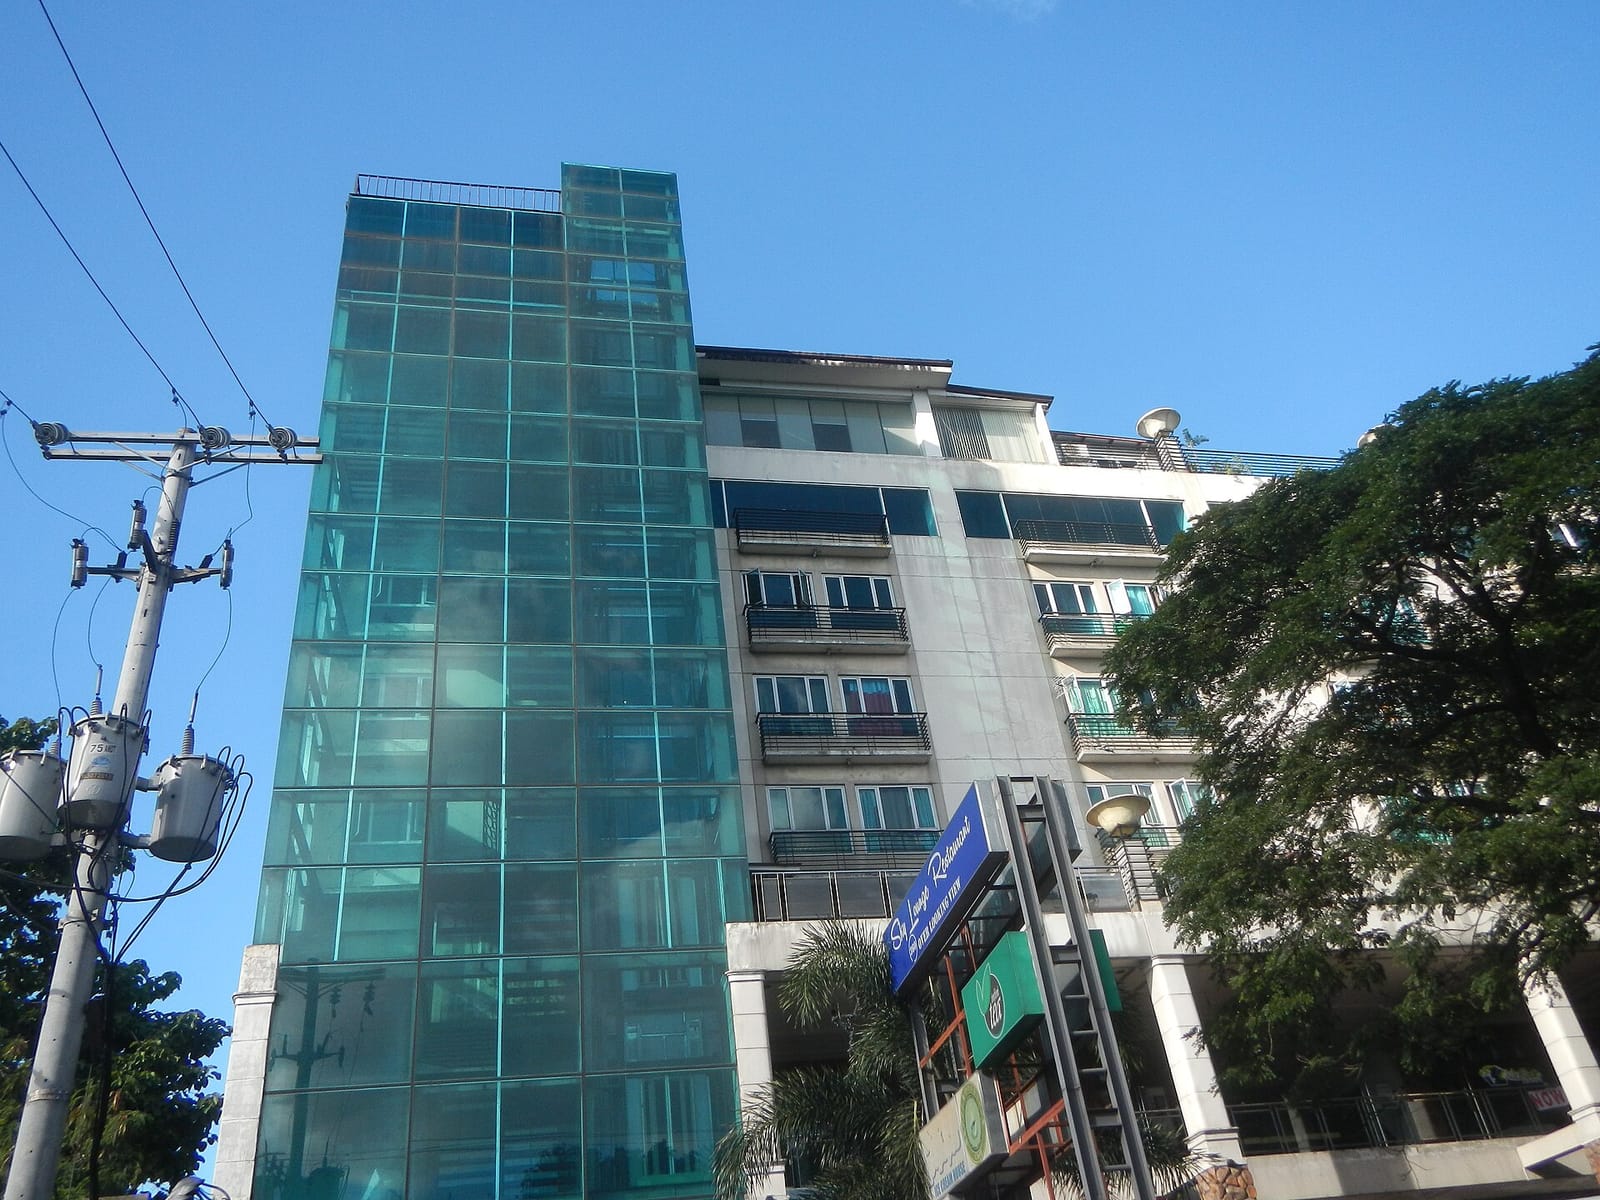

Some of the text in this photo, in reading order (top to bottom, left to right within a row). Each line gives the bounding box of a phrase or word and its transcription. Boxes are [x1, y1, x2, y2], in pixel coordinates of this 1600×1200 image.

[890, 815, 971, 950] Sky Lounge Restaurant
[917, 876, 961, 950] OVER LOOKING VIEW
